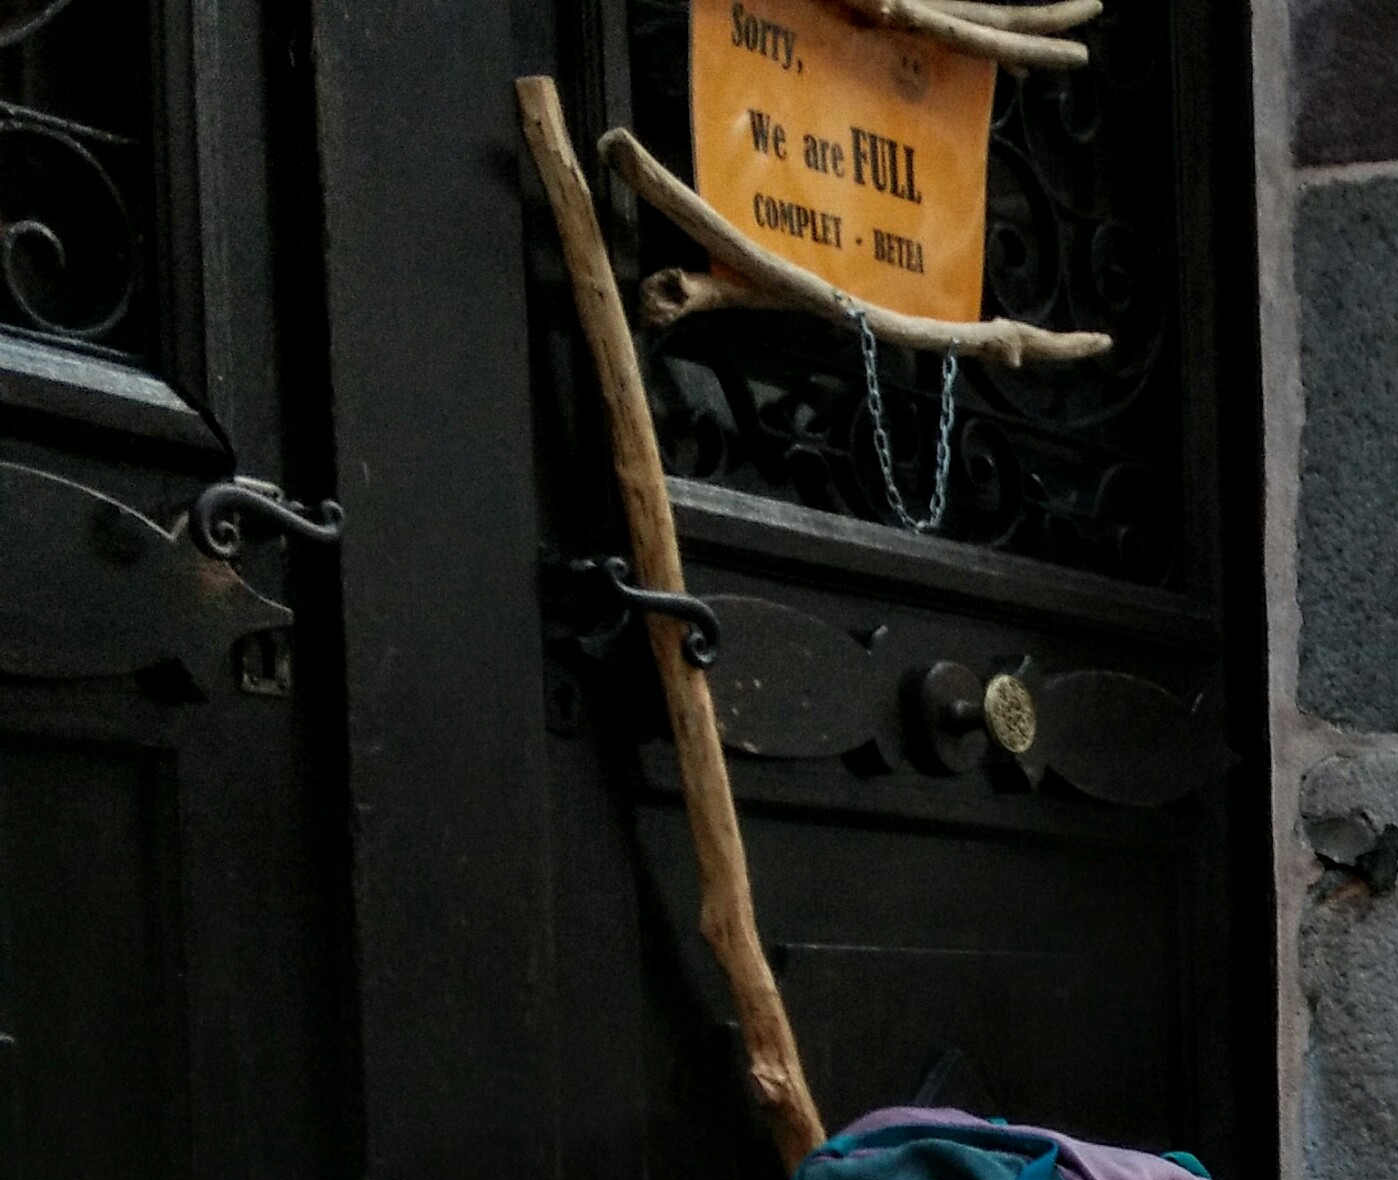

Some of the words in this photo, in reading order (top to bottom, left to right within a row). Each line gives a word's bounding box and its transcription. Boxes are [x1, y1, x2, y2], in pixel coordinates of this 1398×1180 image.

[732, 1, 803, 73] Sorry,
[748, 109, 787, 159] We
[803, 133, 845, 178] are
[851, 127, 922, 204] FULL
[754, 192, 843, 249] COMPLET
[873, 229, 924, 274] BETEA
